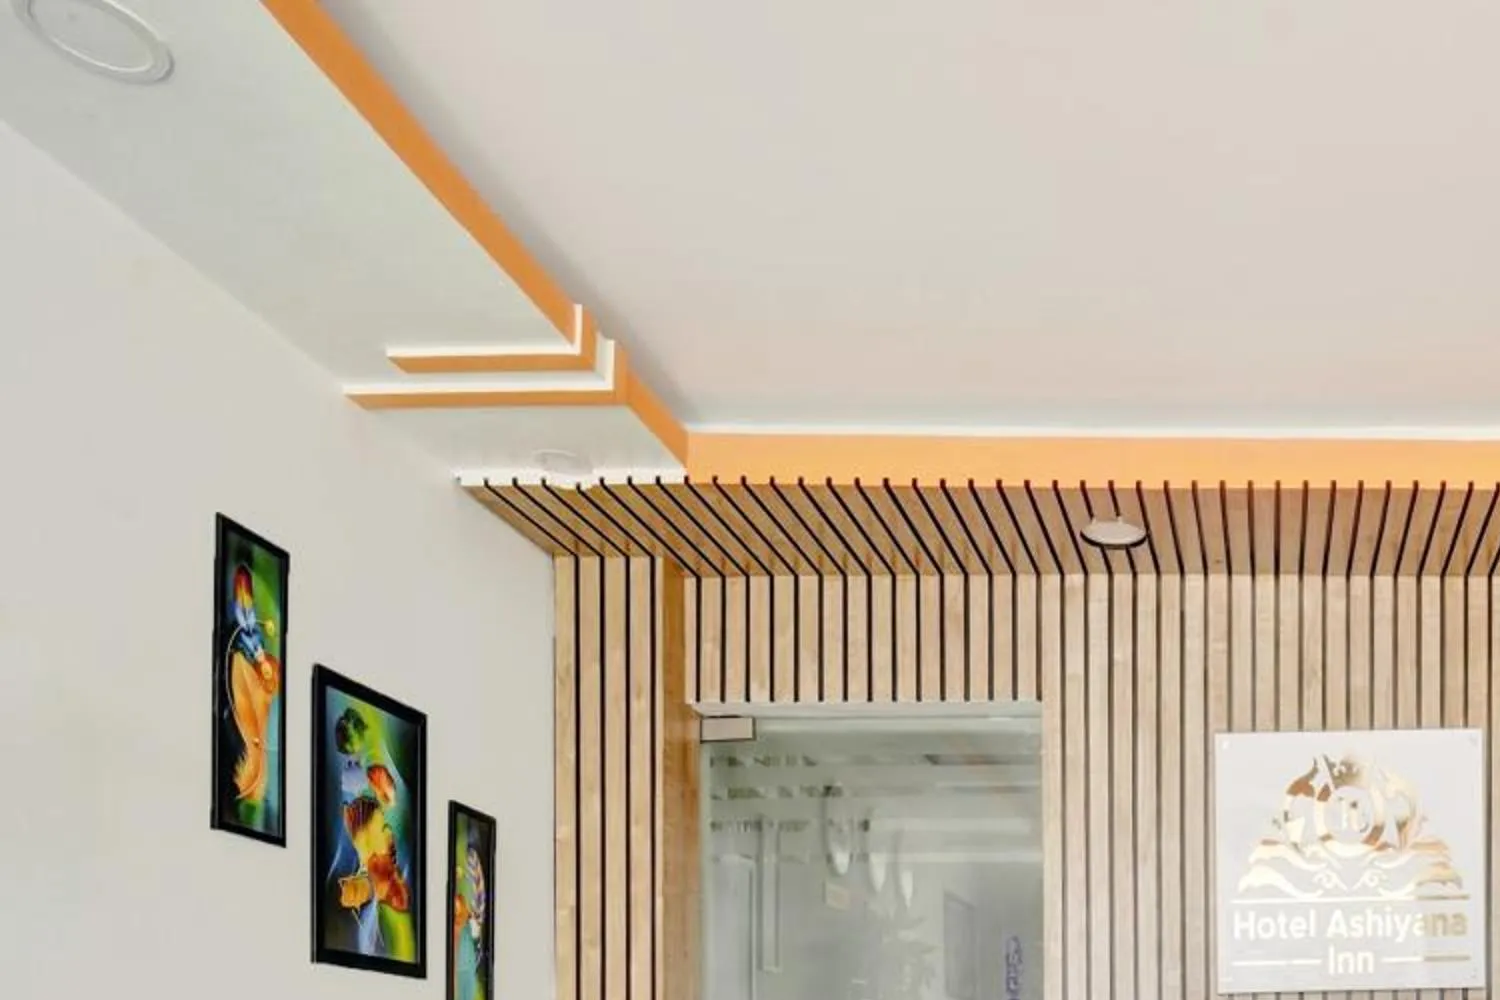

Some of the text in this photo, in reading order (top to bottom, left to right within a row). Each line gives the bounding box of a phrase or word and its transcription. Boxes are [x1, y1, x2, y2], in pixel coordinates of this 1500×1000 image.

[1233, 905, 1468, 943] Hotel Ashiyana
[1327, 943, 1375, 975] Inn
